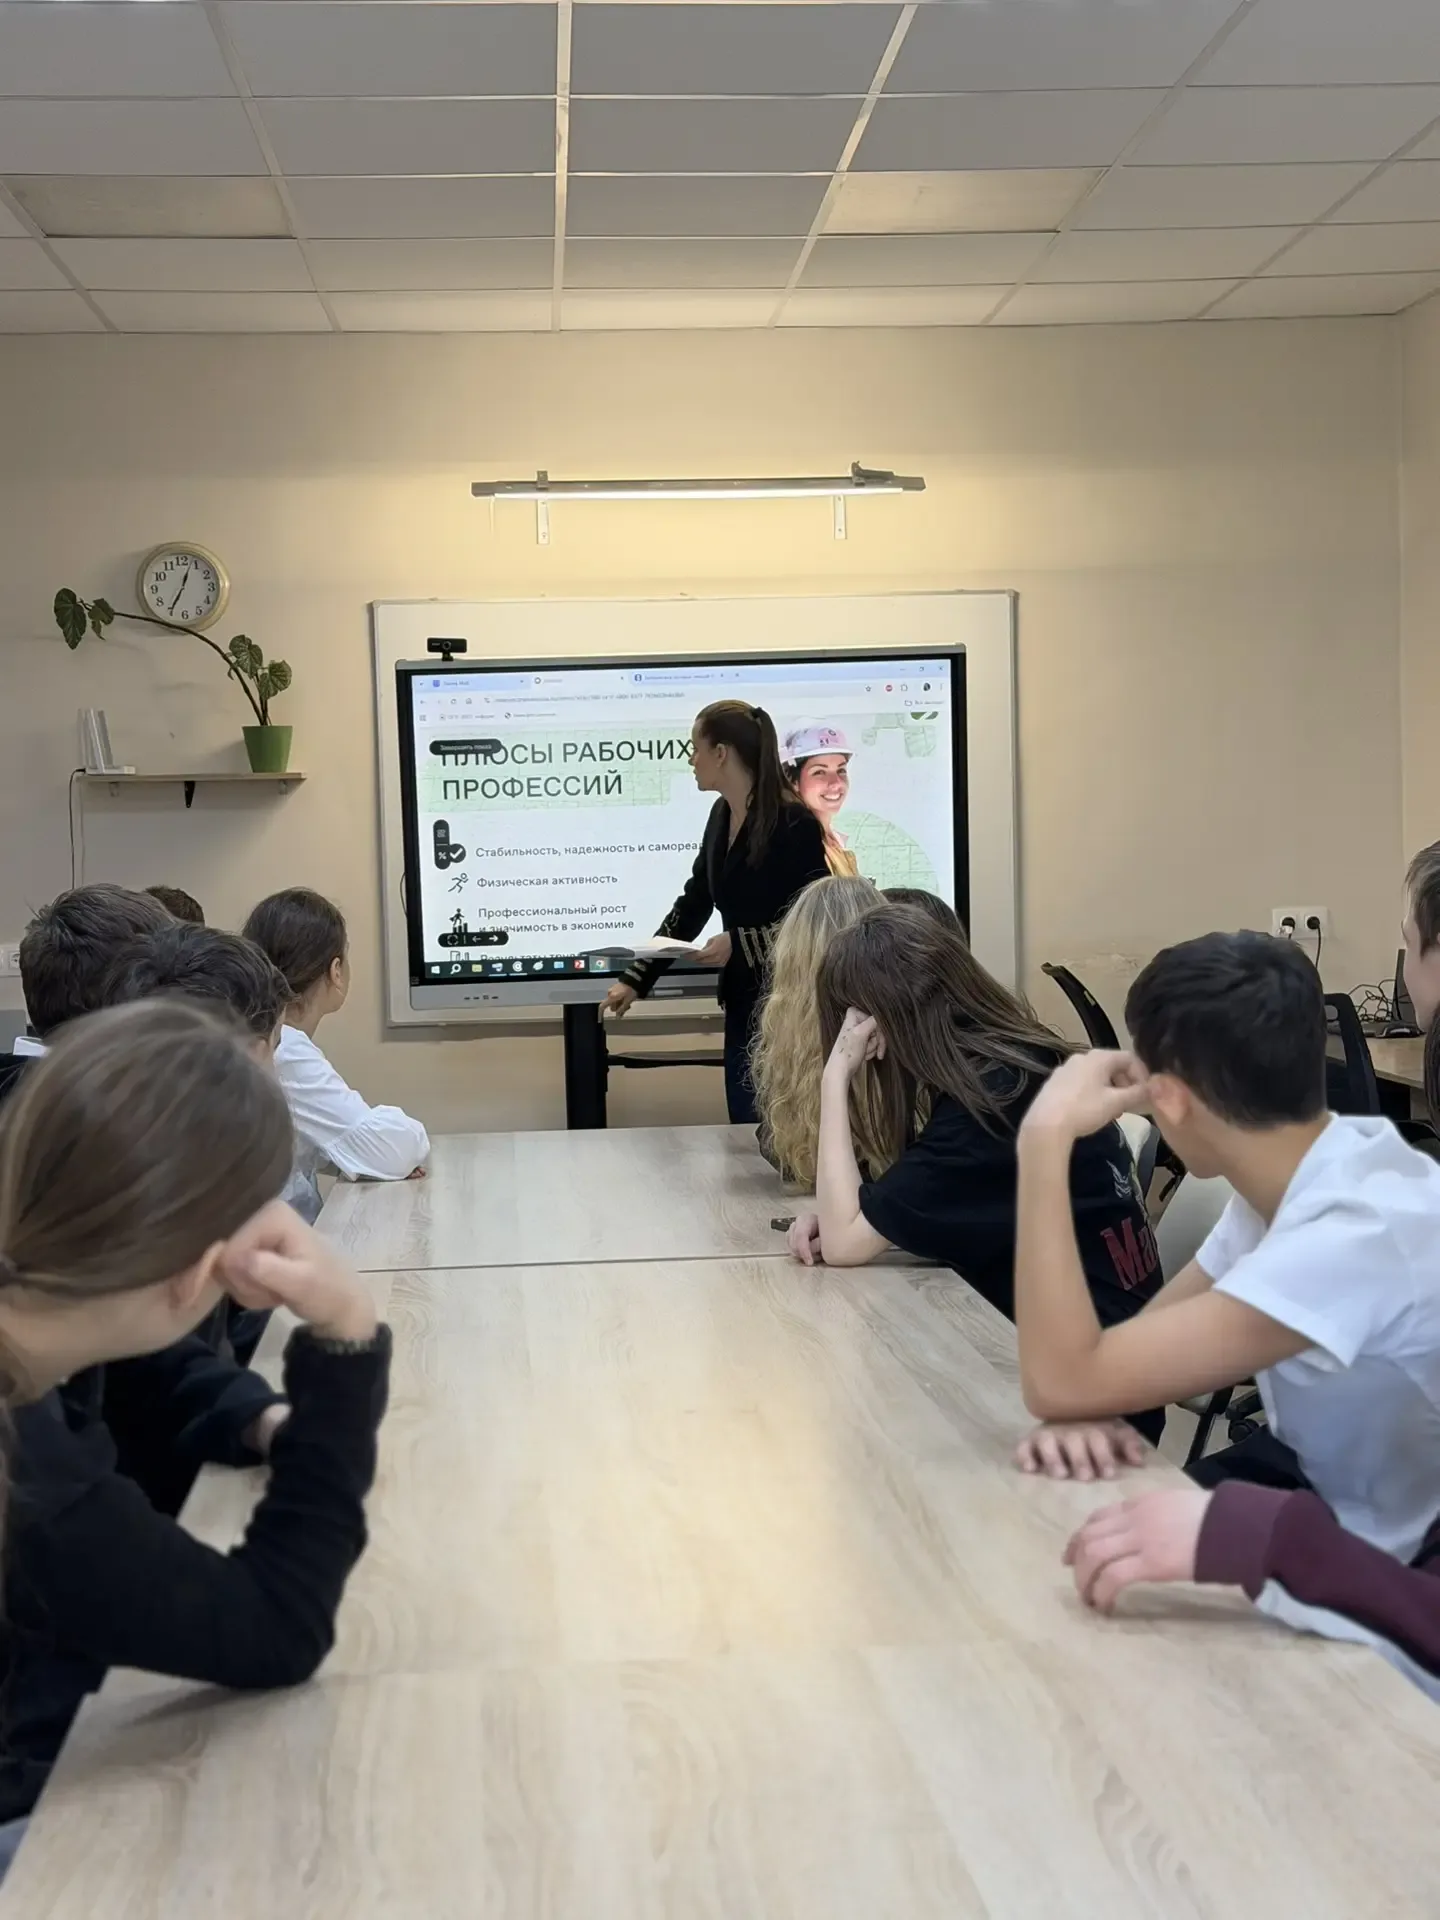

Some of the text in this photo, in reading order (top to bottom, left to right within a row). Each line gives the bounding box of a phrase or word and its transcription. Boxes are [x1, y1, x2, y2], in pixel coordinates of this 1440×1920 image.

[164, 561, 174, 571] 11
[176, 556, 188, 566] 12
[194, 560, 199, 570] 1
[155, 572, 166, 581] 10
[203, 570, 210, 580] 2
[150, 584, 158, 594] 9
[208, 582, 216, 592] 3
[156, 597, 164, 606] 8
[204, 596, 210, 604] 4
[168, 606, 174, 616] 7
[182, 610, 188, 620] 6
[196, 606, 202, 616] 5
[562, 739, 692, 763] РАБОЧИХ
[442, 769, 622, 800] ПРОФЕССИЙ
[475, 846, 561, 858] Стабильность,
[564, 844, 635, 855] надежность
[476, 876, 618, 889] Физическая активность
[478, 905, 627, 919] Профессиональный рост
[571, 920, 634, 930] экономике
[1100, 1216, 1157, 1291] Ma
